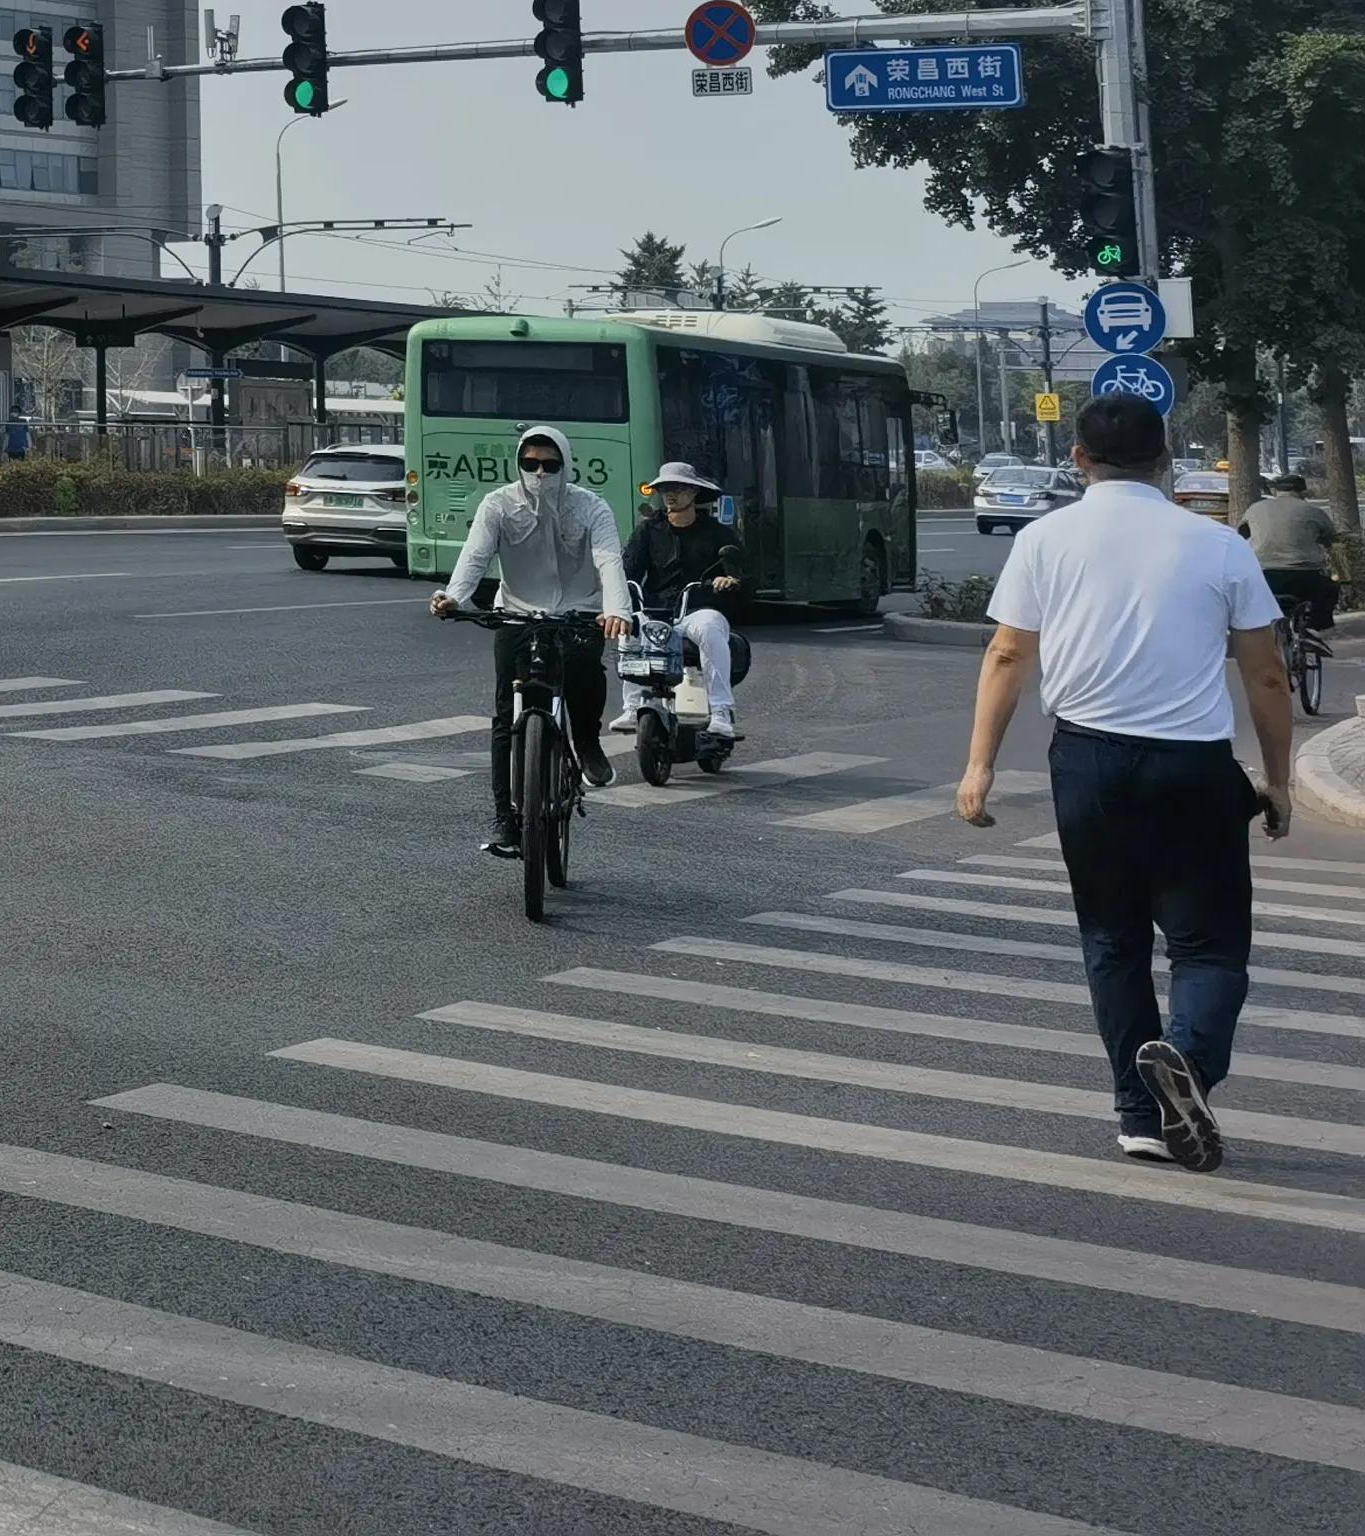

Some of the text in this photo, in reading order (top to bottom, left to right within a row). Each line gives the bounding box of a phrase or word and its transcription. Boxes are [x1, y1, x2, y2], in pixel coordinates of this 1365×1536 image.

[886, 56, 1002, 81] 荣昌西街
[695, 72, 748, 92] 荣昌西街
[887, 84, 1004, 99] RONGCHANG West St
